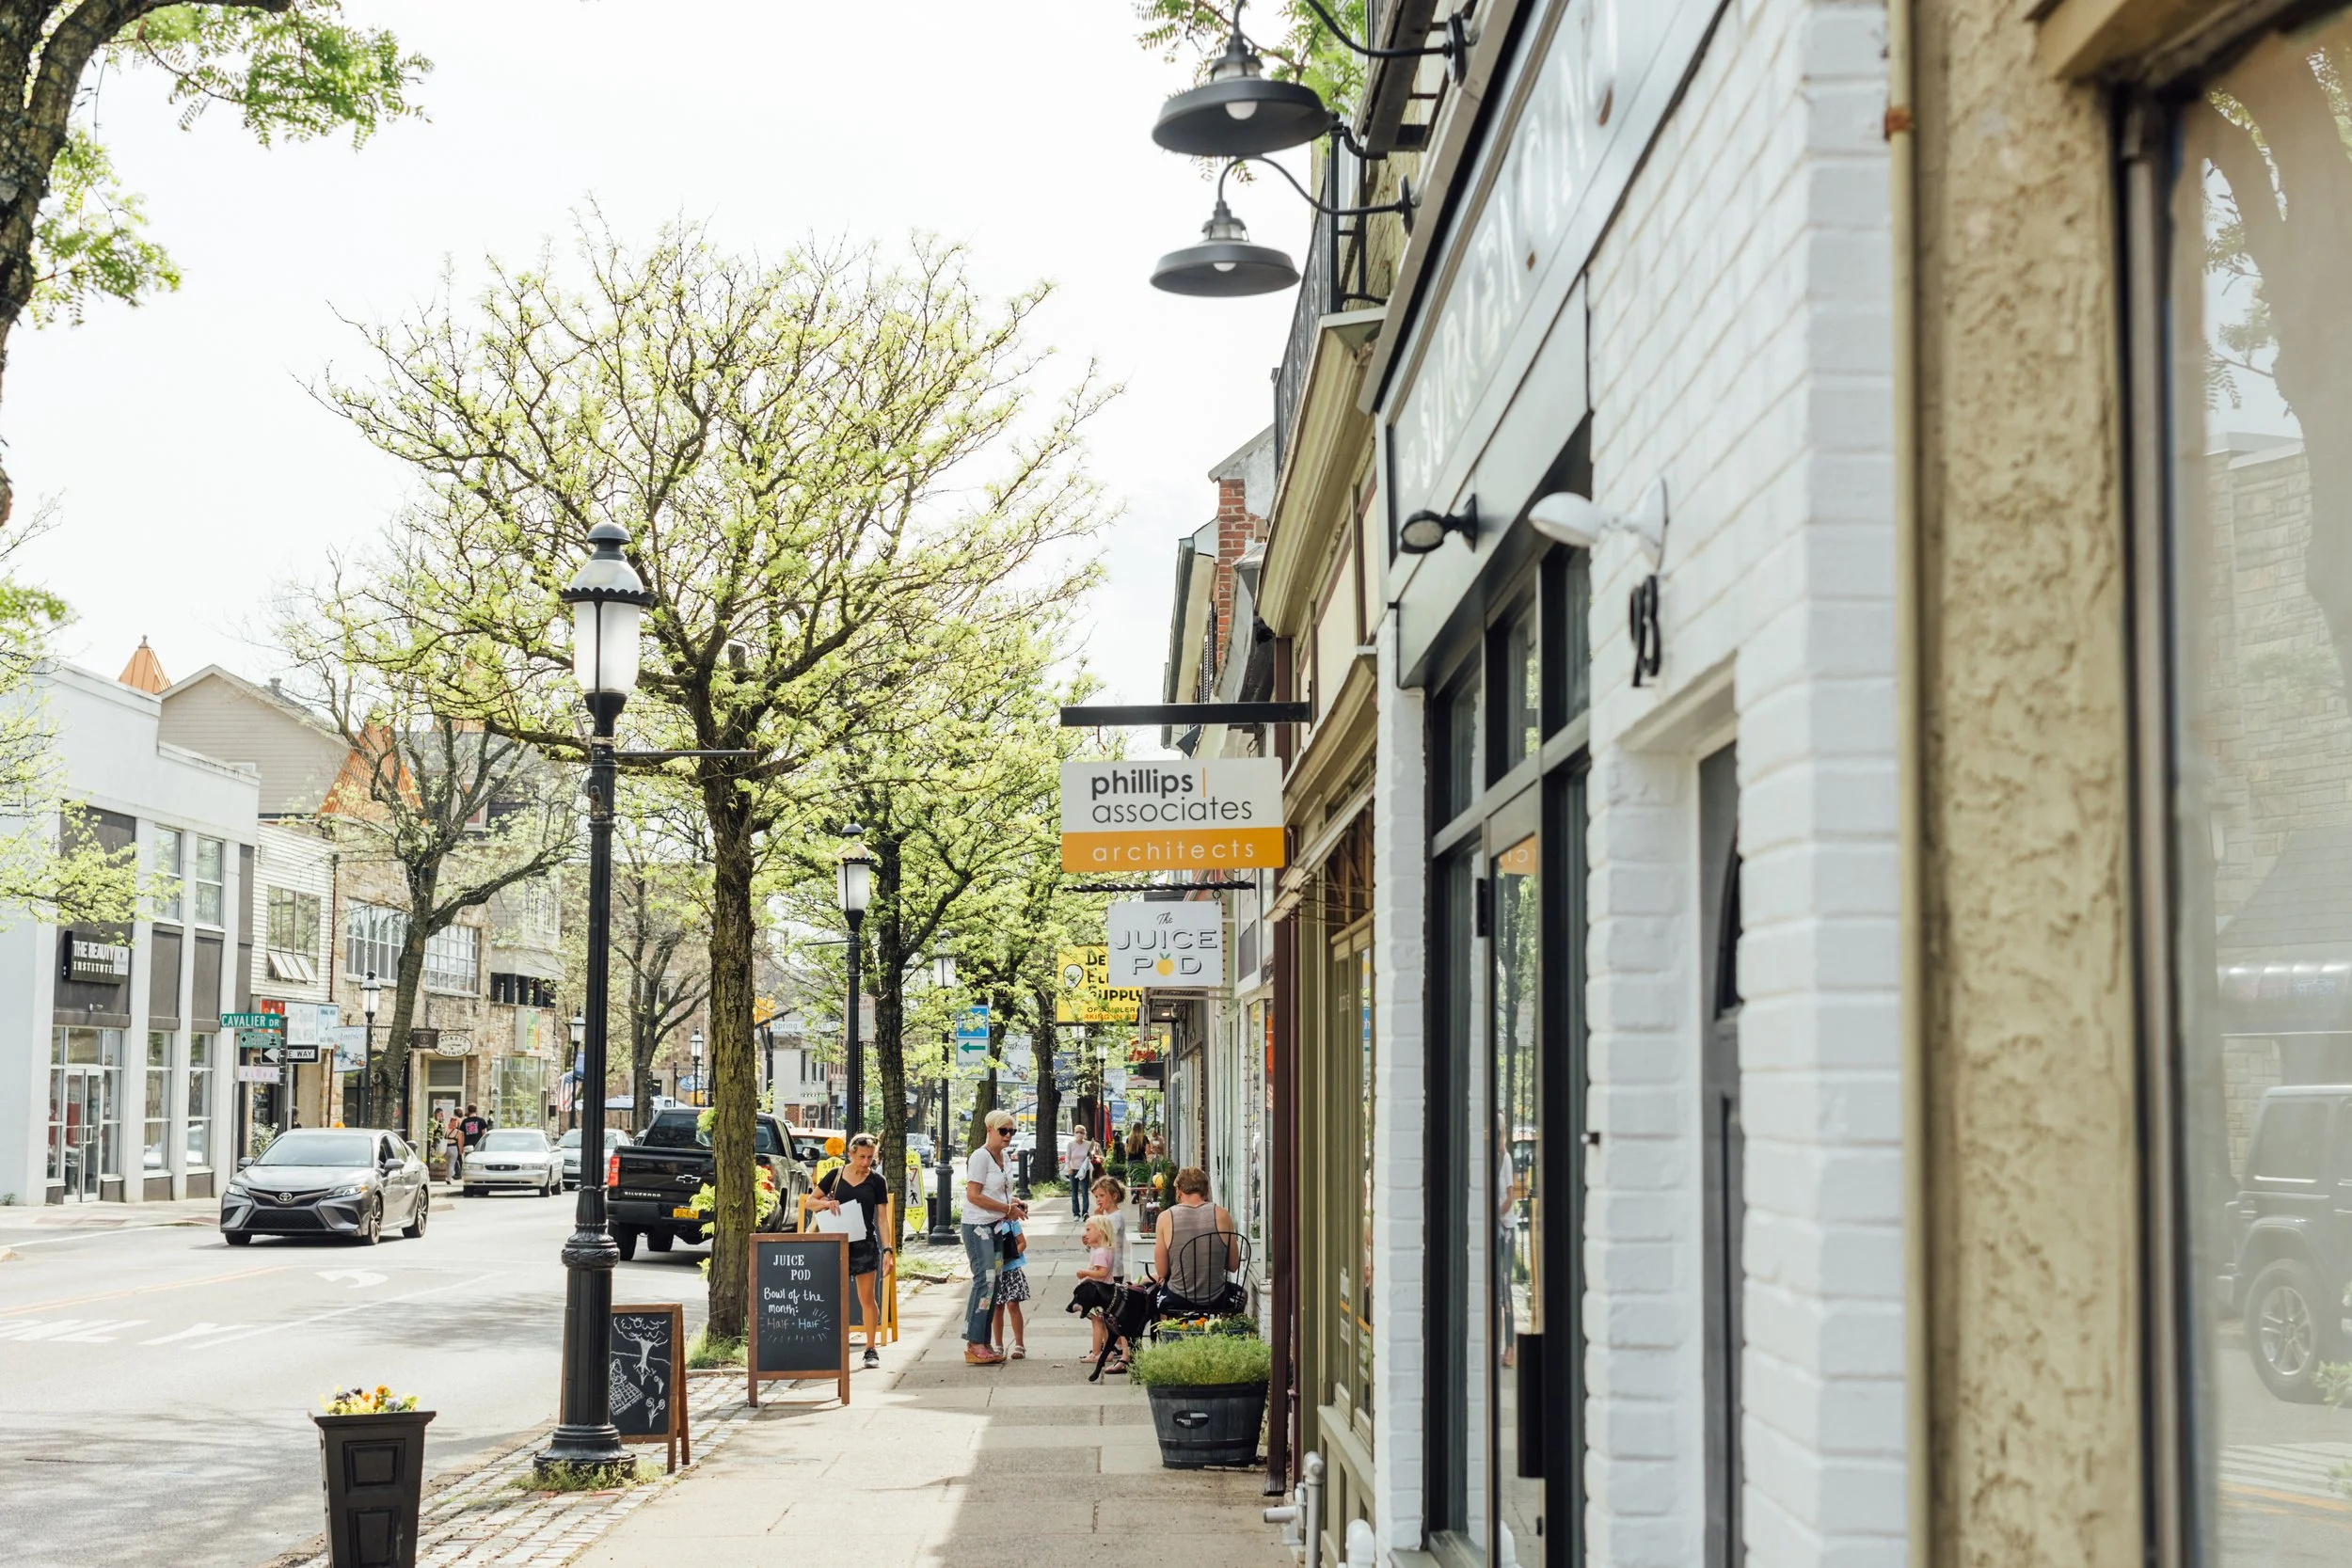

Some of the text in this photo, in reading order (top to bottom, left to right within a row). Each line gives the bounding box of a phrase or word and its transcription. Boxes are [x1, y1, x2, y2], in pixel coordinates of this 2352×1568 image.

[1091, 768, 1194, 800] phillips
[1092, 796, 1252, 824] associates
[1092, 839, 1254, 863] architects
[1156, 911, 1173, 926] The
[1114, 929, 1218, 950] JUICE
[72, 941, 115, 960] THE BEAUTY
[73, 960, 113, 974] INSTITUTE
[221, 1014, 279, 1027] CAVALIER DR
[773, 1022, 798, 1031] Spring
[297, 1050, 313, 1058] WAY
[772, 1254, 804, 1266] JUICE
[790, 1269, 811, 1281] POD
[763, 1287, 824, 1305] Bowl of the
